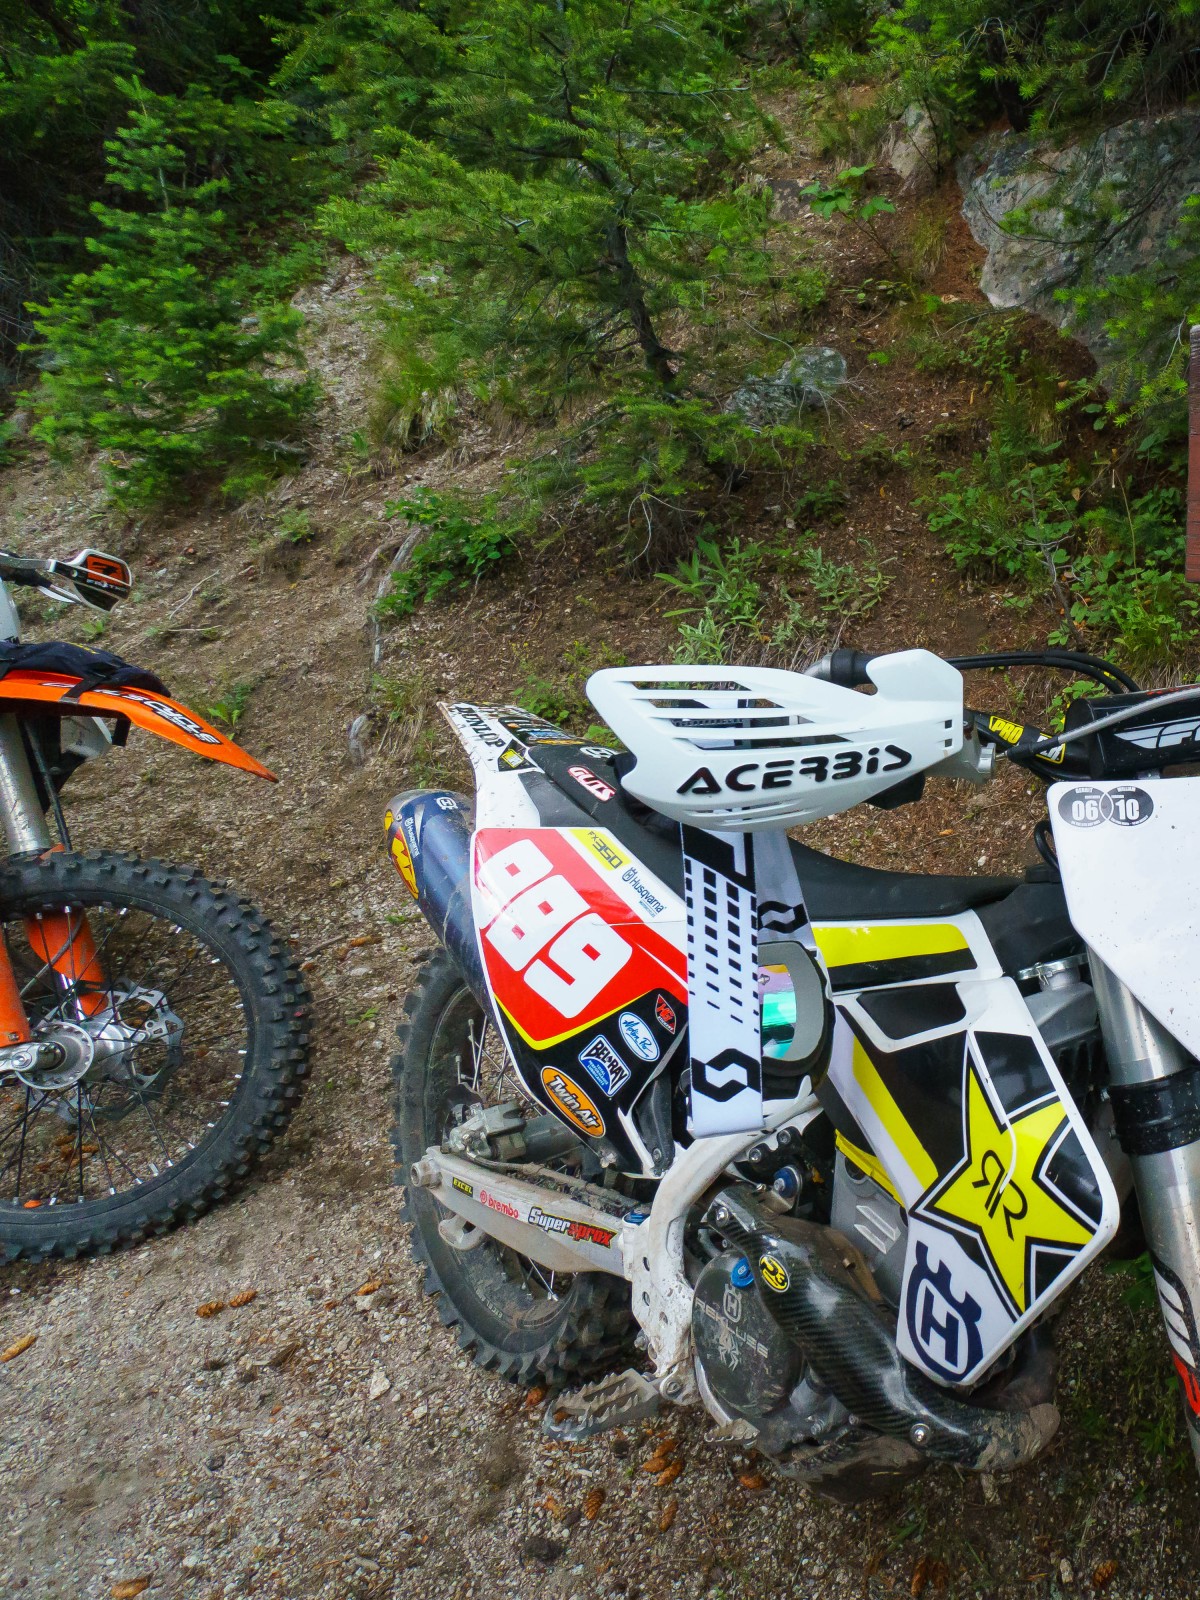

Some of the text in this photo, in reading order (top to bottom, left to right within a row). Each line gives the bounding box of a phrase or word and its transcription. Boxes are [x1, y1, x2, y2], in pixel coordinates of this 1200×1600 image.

[569, 766, 615, 801] GUTS
[677, 744, 912, 794] ACERBIS
[1072, 800, 1099, 821] 06
[1115, 798, 1139, 821] 10
[592, 838, 623, 869] 350
[629, 876, 665, 914] Husqvarna
[487, 1194, 519, 1219] brembo
